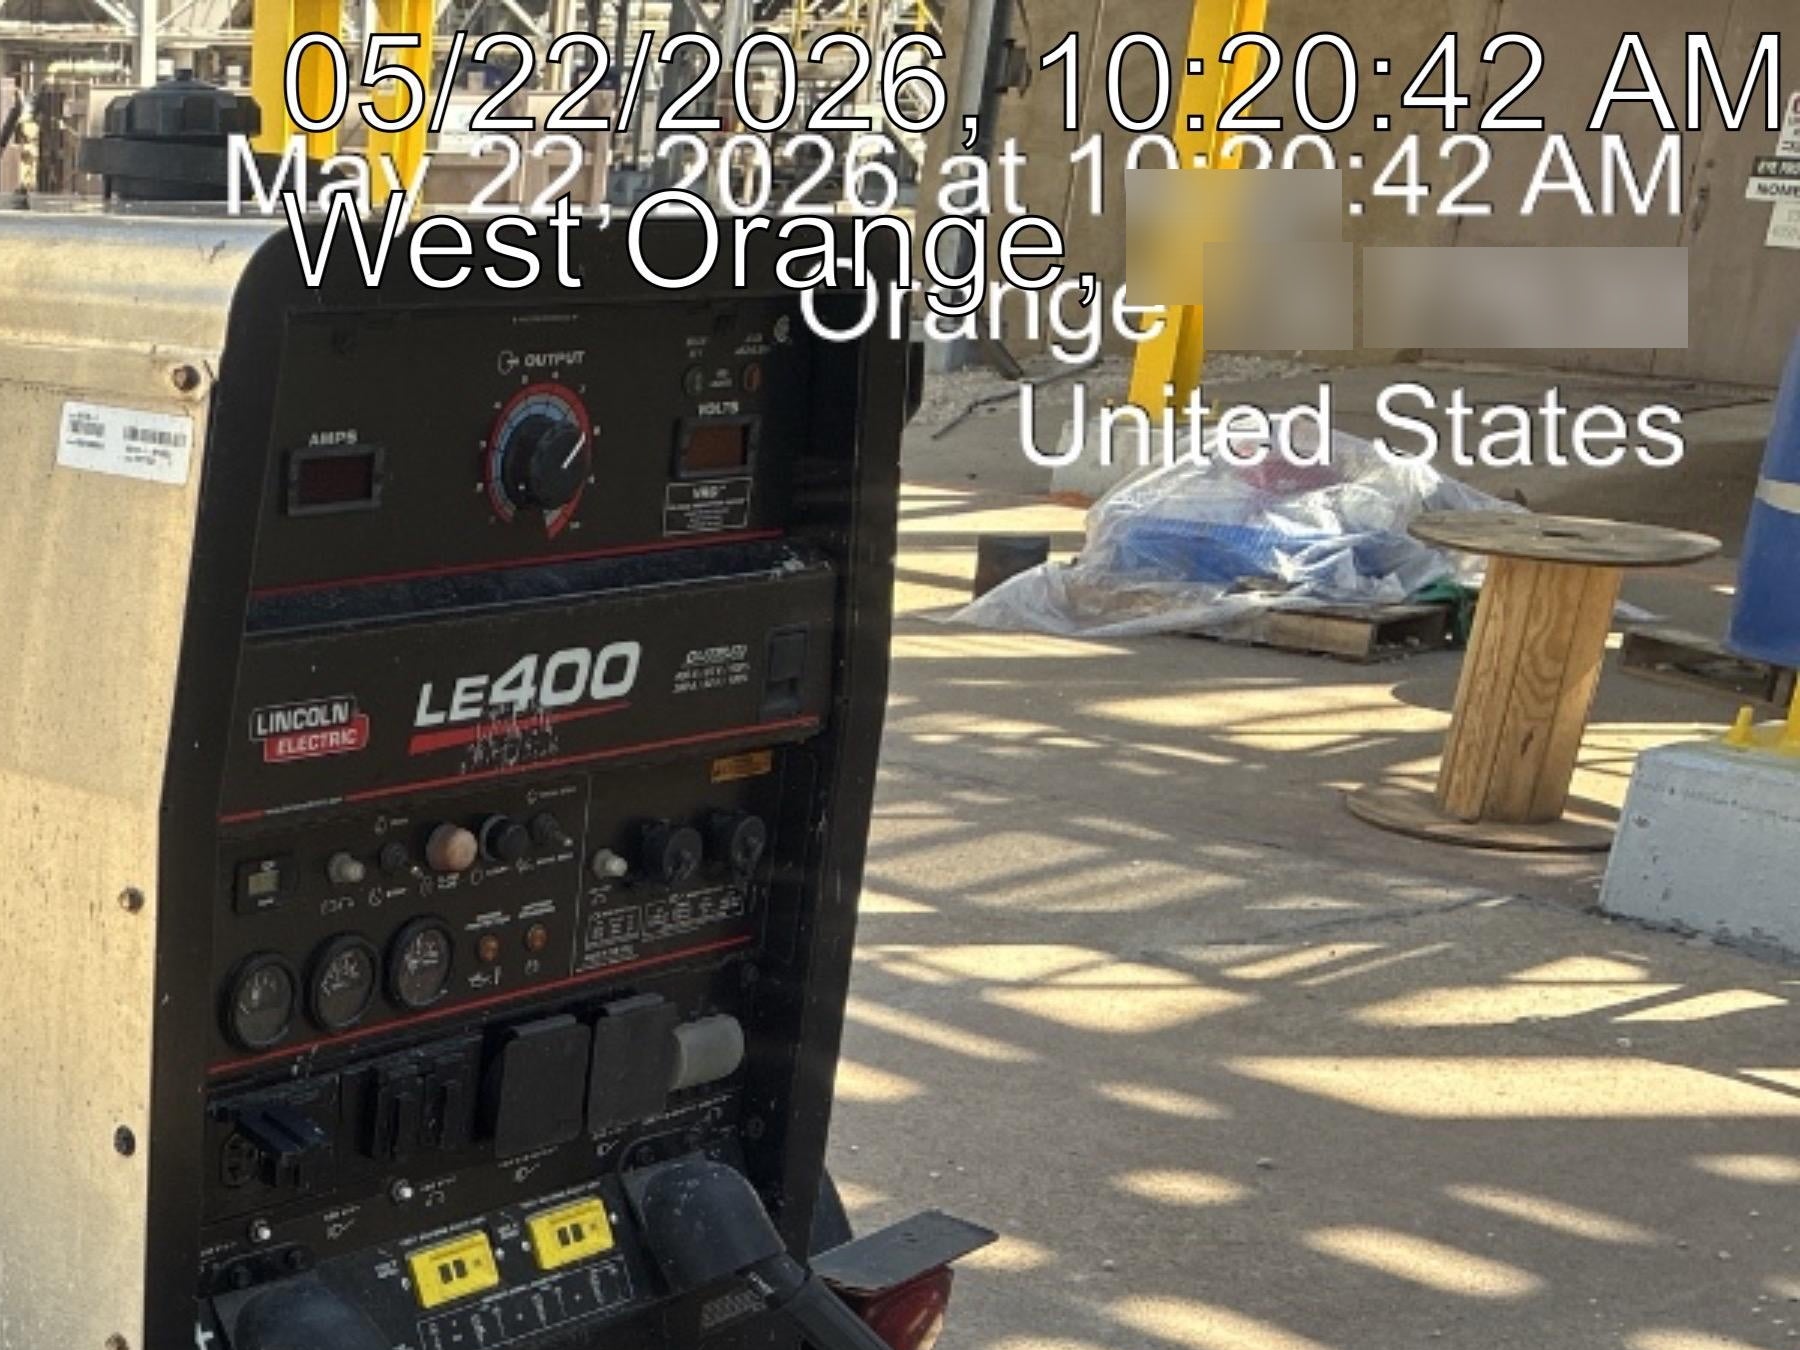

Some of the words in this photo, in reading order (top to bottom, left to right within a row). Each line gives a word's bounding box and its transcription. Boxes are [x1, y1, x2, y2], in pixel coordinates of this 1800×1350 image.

[524, 351, 585, 367] OUTPUT
[309, 429, 358, 446] AMPS
[413, 641, 641, 727] LE400
[256, 701, 350, 736] LINCOLN
[276, 727, 358, 755] ELECTRIC
